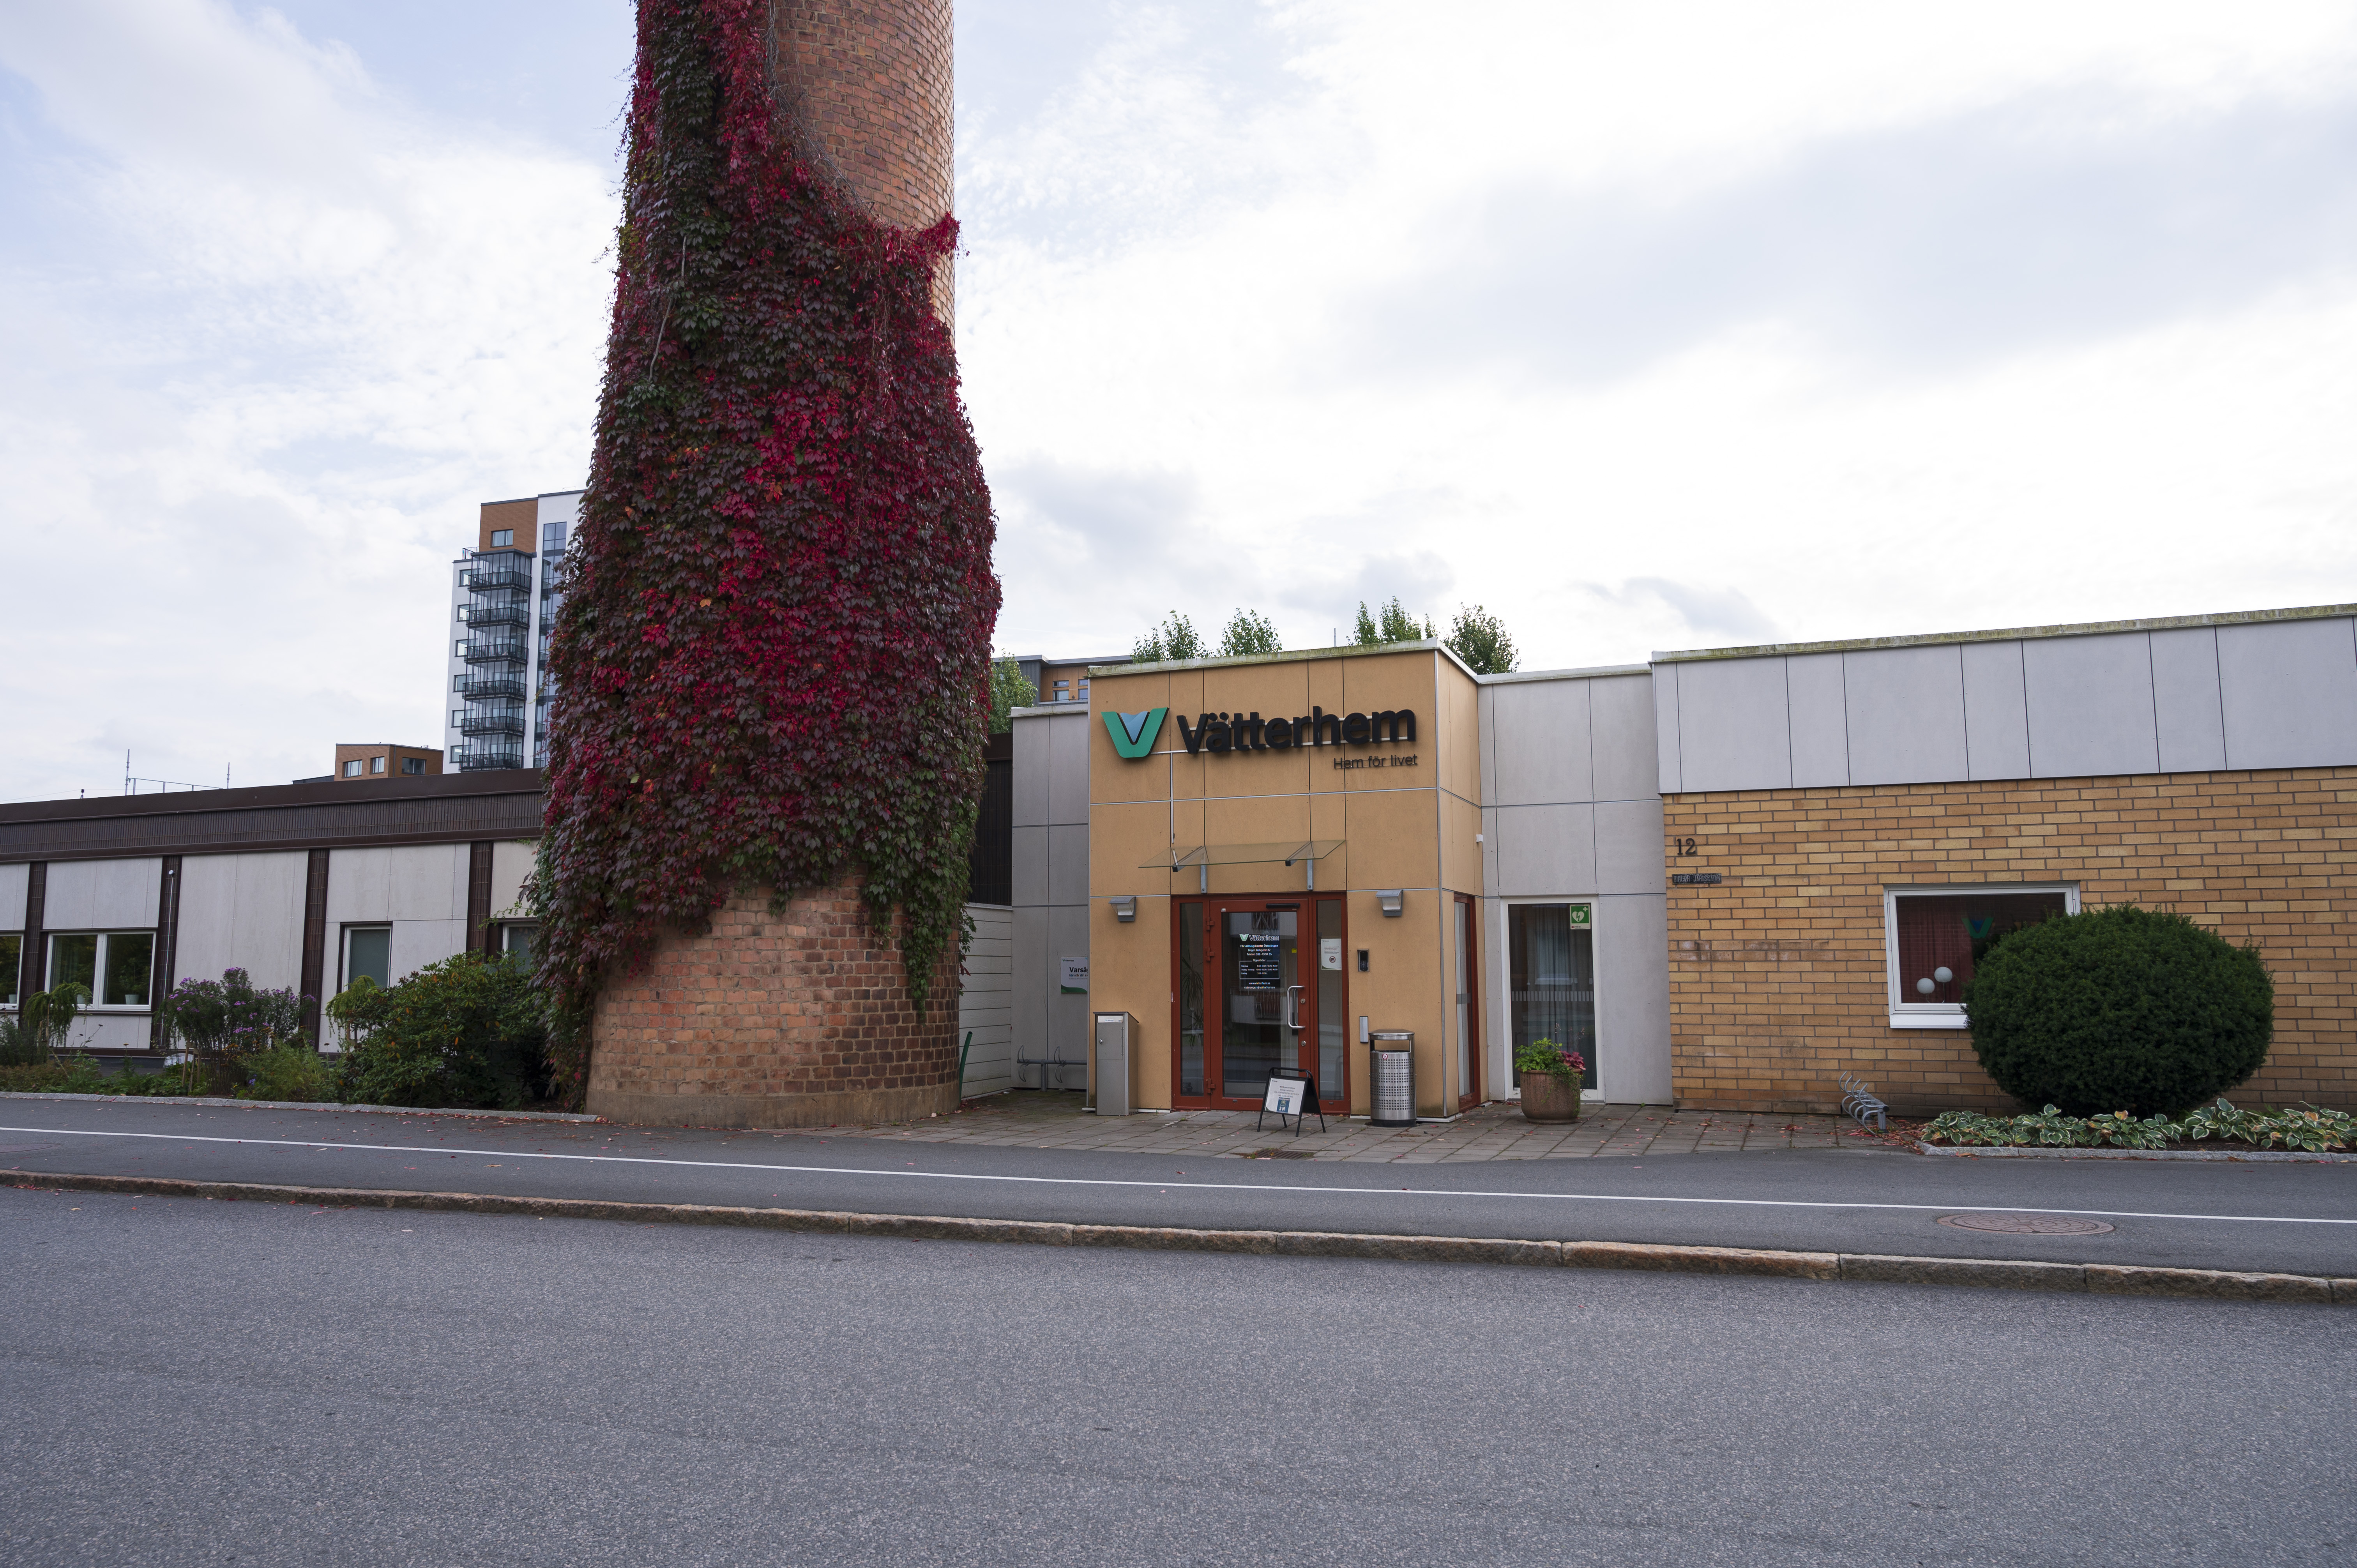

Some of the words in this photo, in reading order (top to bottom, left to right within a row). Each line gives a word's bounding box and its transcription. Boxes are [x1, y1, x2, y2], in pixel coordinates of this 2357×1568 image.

[1176, 706, 1416, 754] Vätterhem
[1334, 757, 1363, 769] Hem
[1368, 756, 1386, 767] för
[1391, 754, 1417, 766] livet
[1677, 838, 1696, 855] 12
